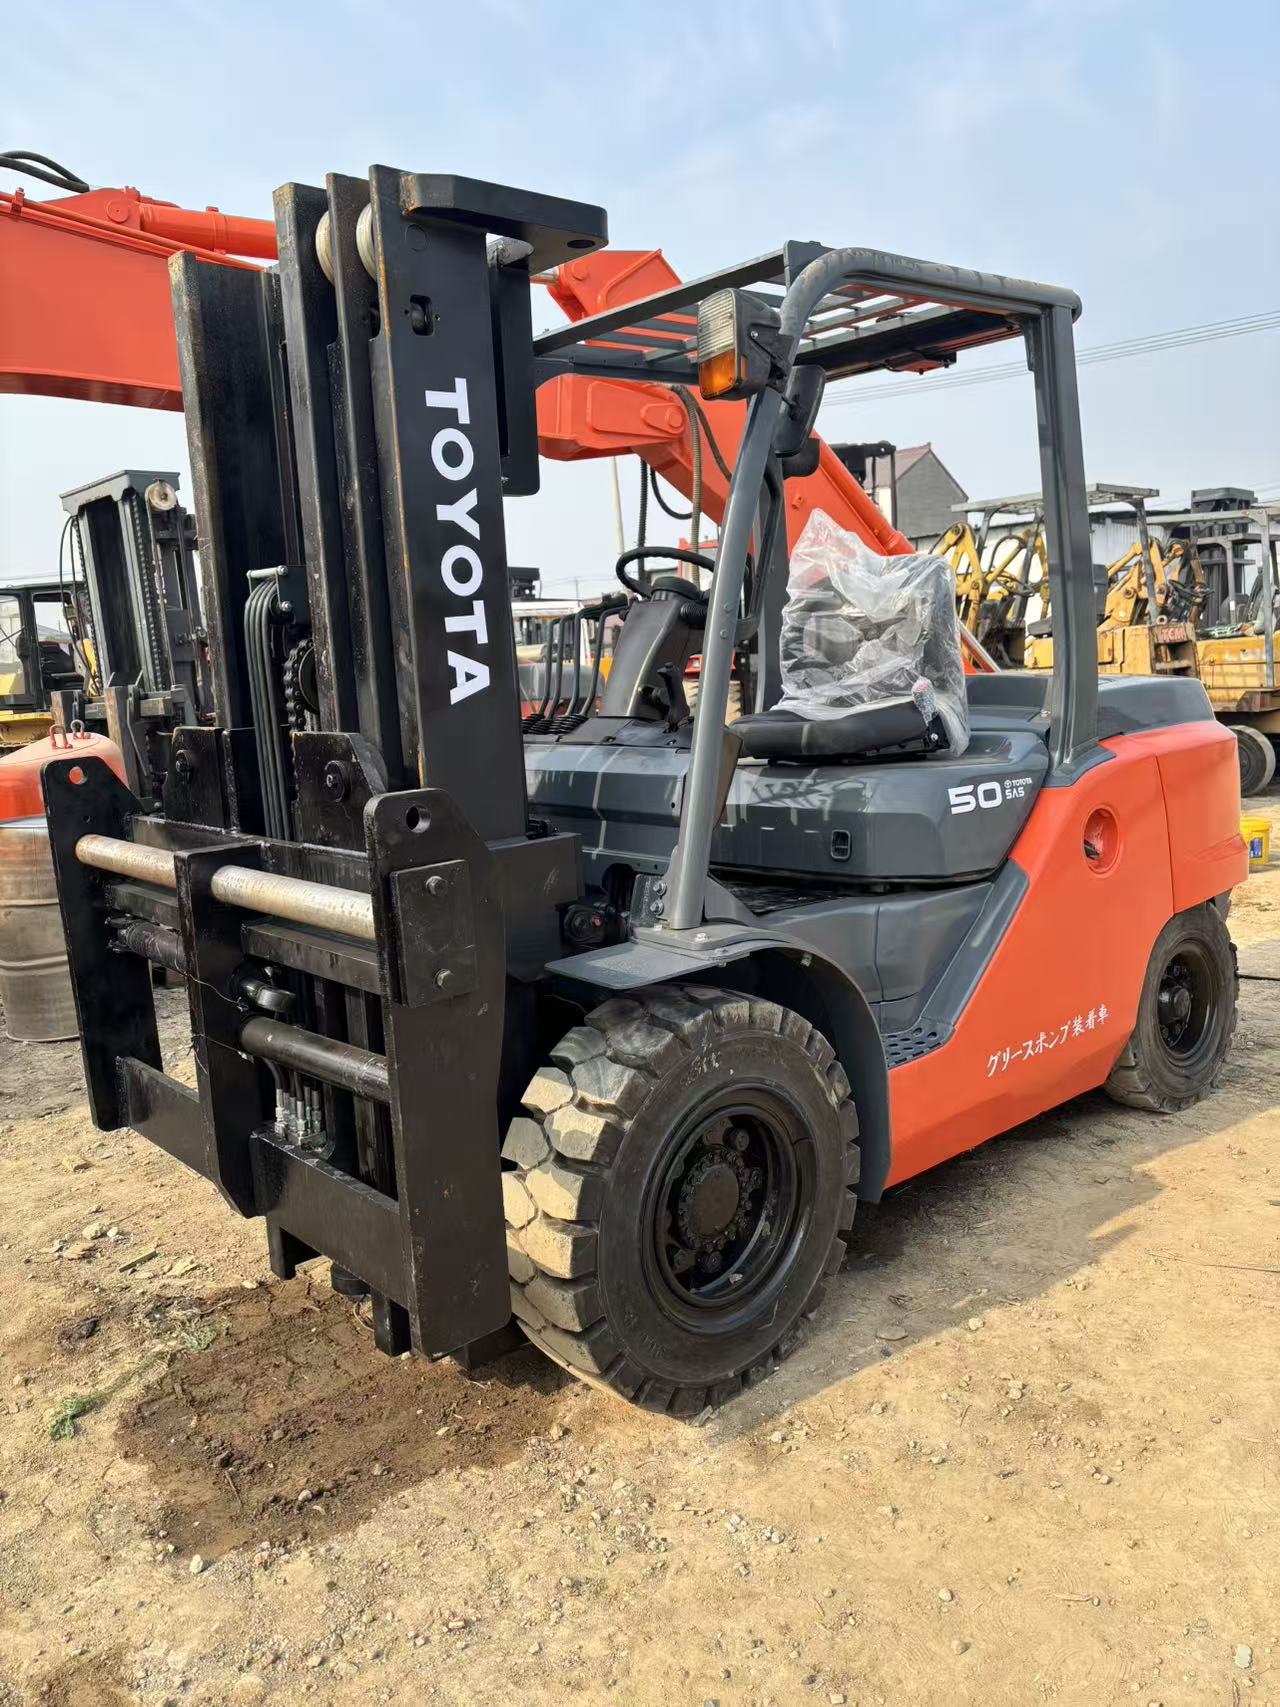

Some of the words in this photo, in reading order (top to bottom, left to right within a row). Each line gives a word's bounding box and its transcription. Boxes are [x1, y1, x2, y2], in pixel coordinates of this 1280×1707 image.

[424, 377, 490, 706] TOYOTA
[1161, 627, 1185, 641] TCM
[1012, 777, 1033, 787] TOYOTA
[948, 781, 1003, 815] 50
[1005, 786, 1025, 800] SAS
